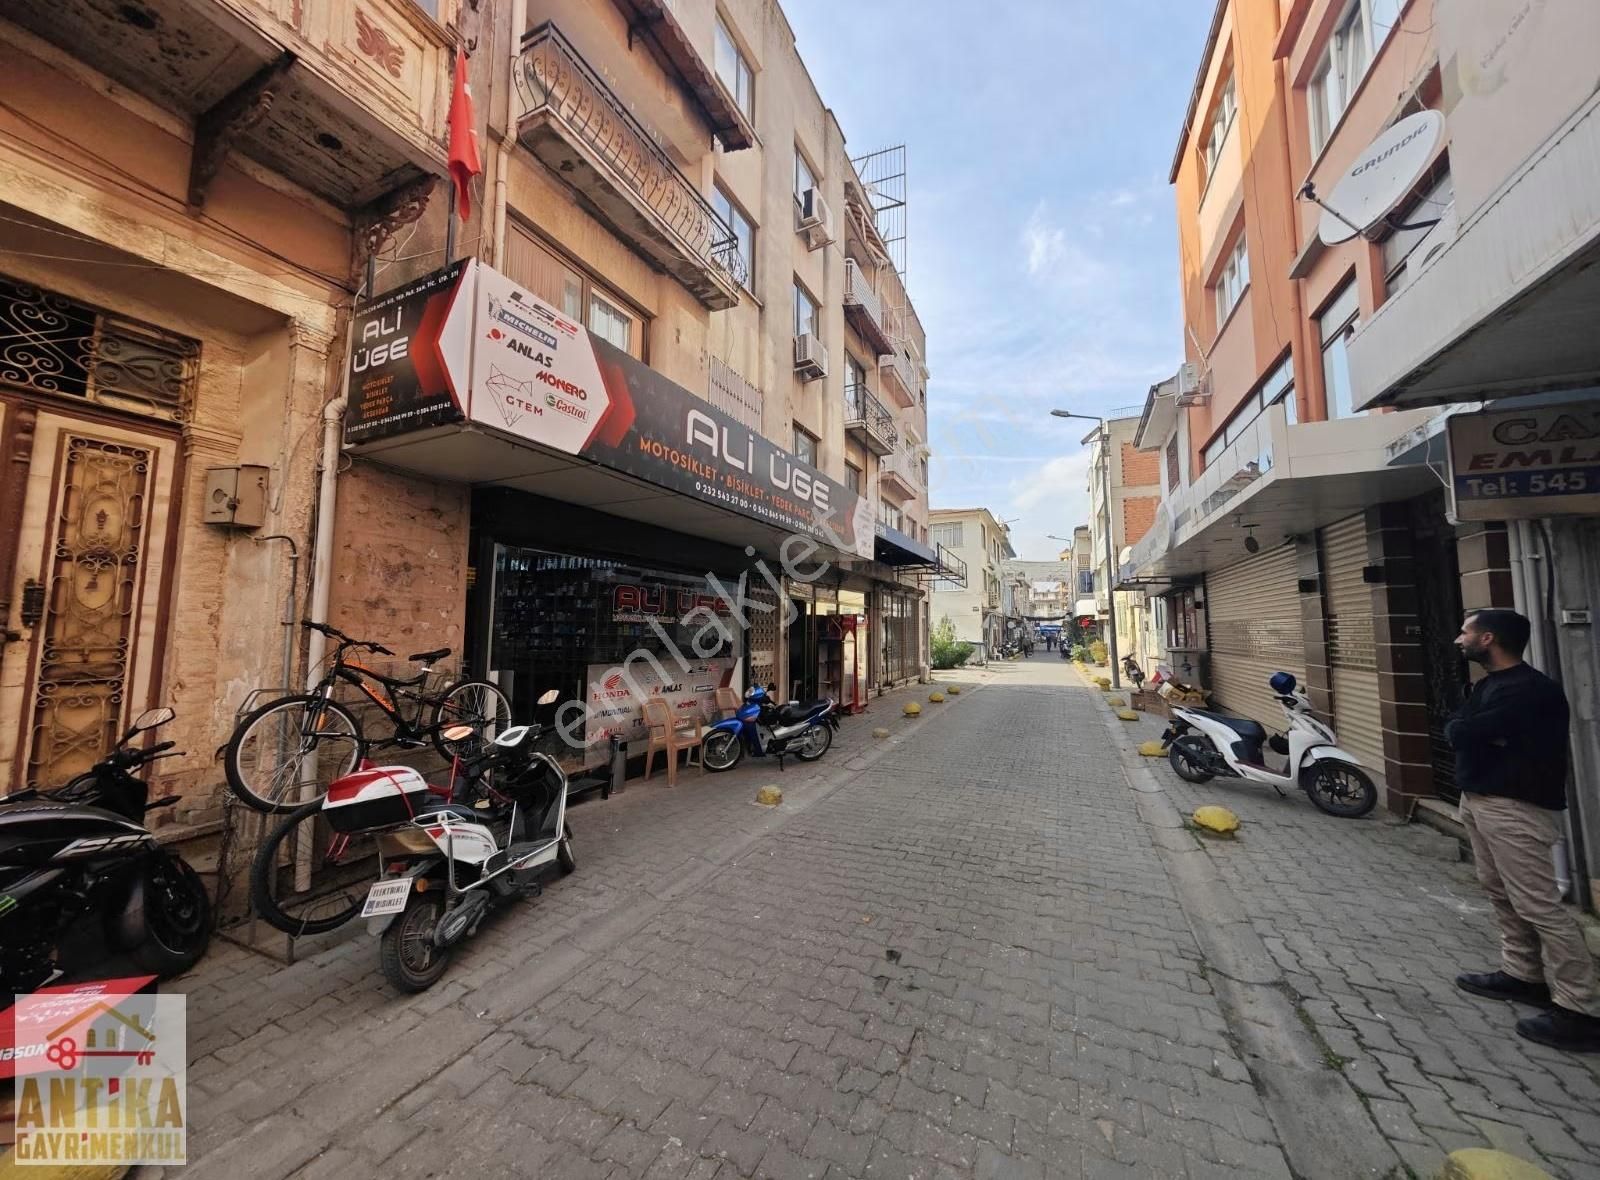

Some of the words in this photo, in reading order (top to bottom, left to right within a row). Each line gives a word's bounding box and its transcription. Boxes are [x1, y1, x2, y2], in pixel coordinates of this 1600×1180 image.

[1352, 122, 1428, 176] GRUNDIG
[362, 306, 402, 343] ALİ
[503, 313, 556, 347] MICHELIN
[353, 336, 409, 373] ÜGE
[506, 338, 553, 368] ANLAS
[535, 370, 587, 401] MONERO
[506, 395, 543, 416] GTEM
[556, 400, 587, 420] Castrol
[1493, 412, 1600, 445] CA
[640, 436, 718, 481] MOTOSİKLET
[772, 495, 793, 512] YEDEK
[686, 409, 754, 474] ALİ
[770, 450, 830, 511] ÜGE
[695, 481, 701, 491] 0
[703, 484, 716, 497] 232
[717, 489, 730, 502] 543
[731, 495, 739, 505] 27
[740, 500, 748, 509] 00
[753, 504, 757, 512] 0
[1466, 476, 1519, 496] Tel:
[1529, 471, 1588, 493] 545
[593, 689, 631, 700] HONDA
[661, 683, 682, 694] ANLAS
